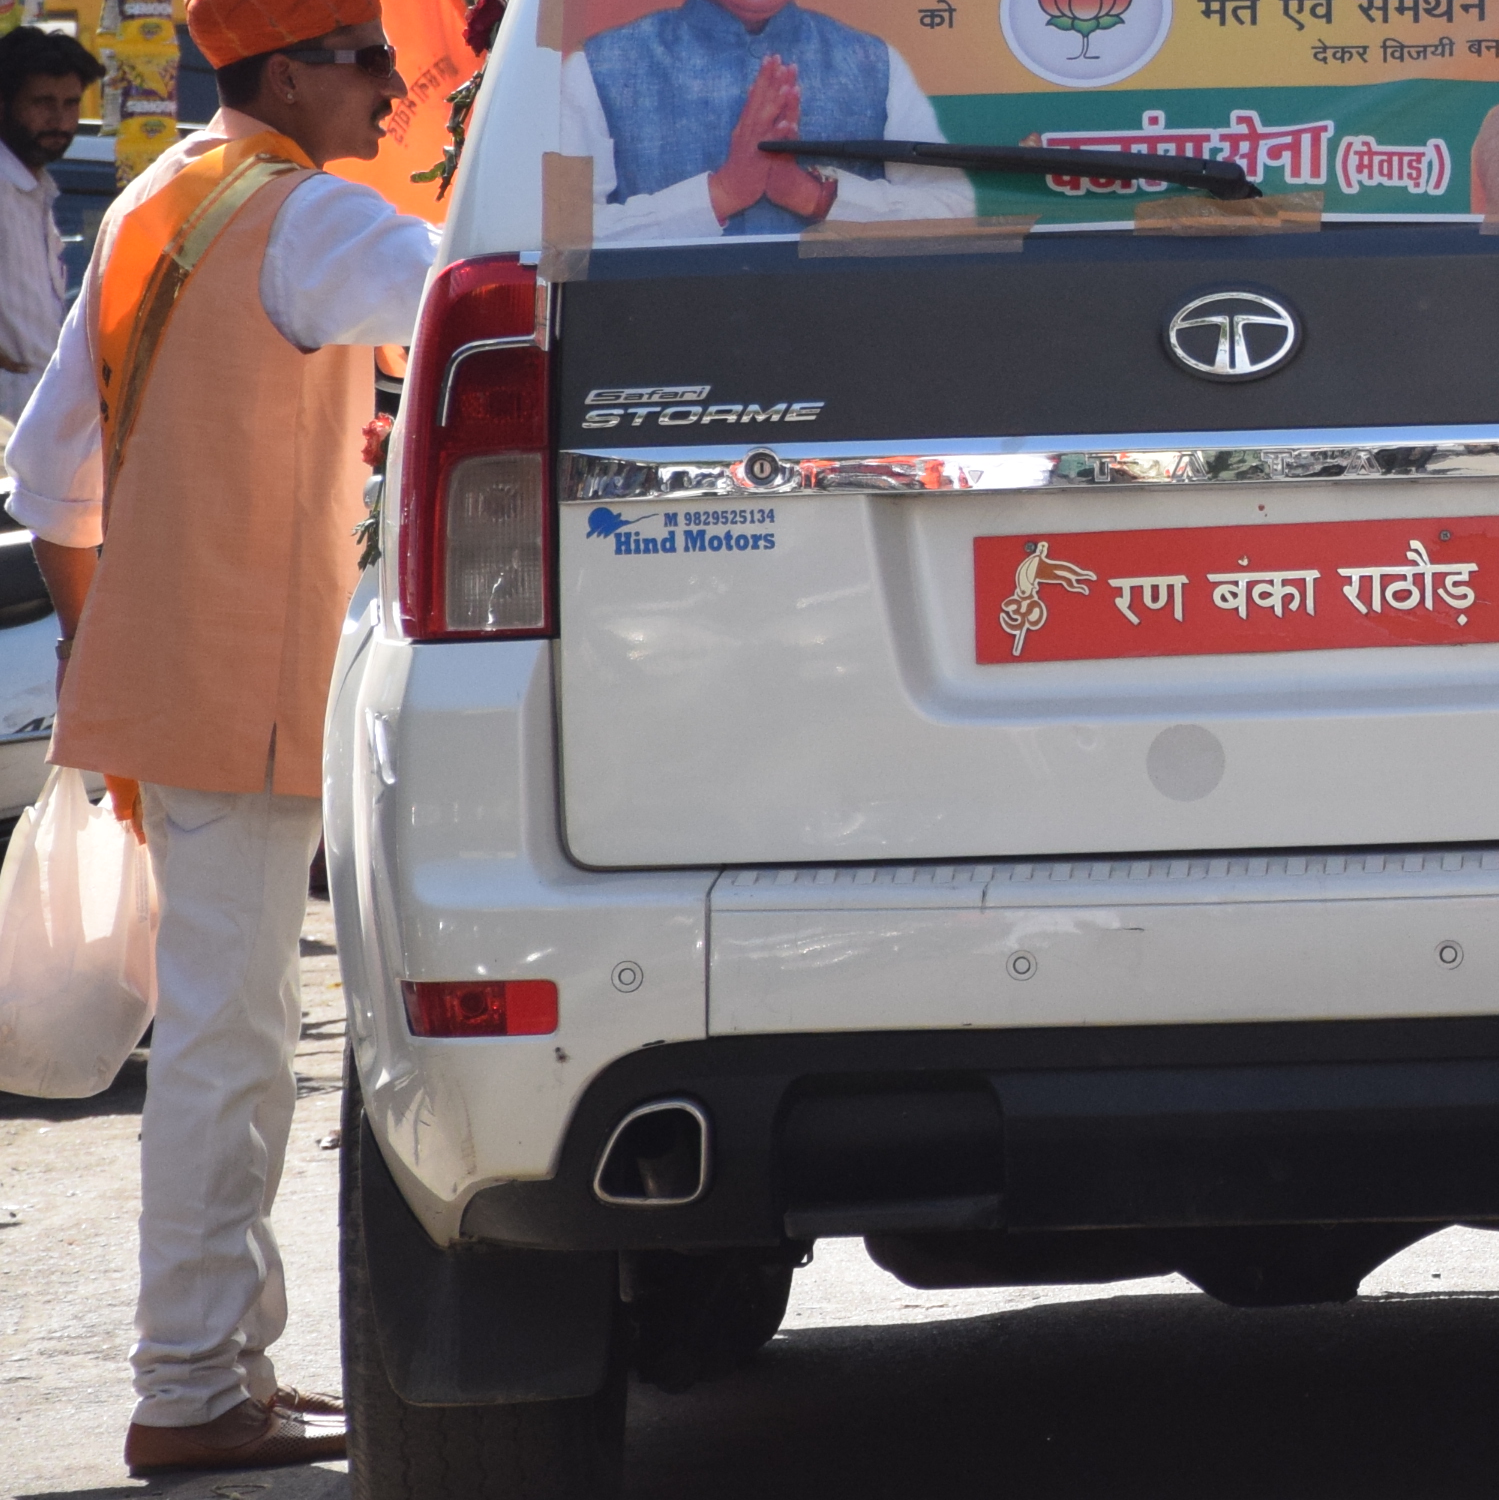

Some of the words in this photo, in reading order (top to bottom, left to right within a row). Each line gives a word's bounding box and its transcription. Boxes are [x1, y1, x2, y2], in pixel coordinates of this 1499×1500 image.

[1311, 38, 1370, 64] देकर
[1380, 35, 1456, 64] विजयी
[587, 385, 711, 404] Safari
[581, 402, 824, 429] STORME
[663, 512, 679, 528] M
[684, 508, 776, 527] 9829525134
[614, 531, 677, 556] Hind
[683, 529, 777, 554] Motors
[1107, 574, 1190, 625] रण
[1206, 554, 1322, 620] बंका
[1336, 539, 1479, 627] राठौड़
